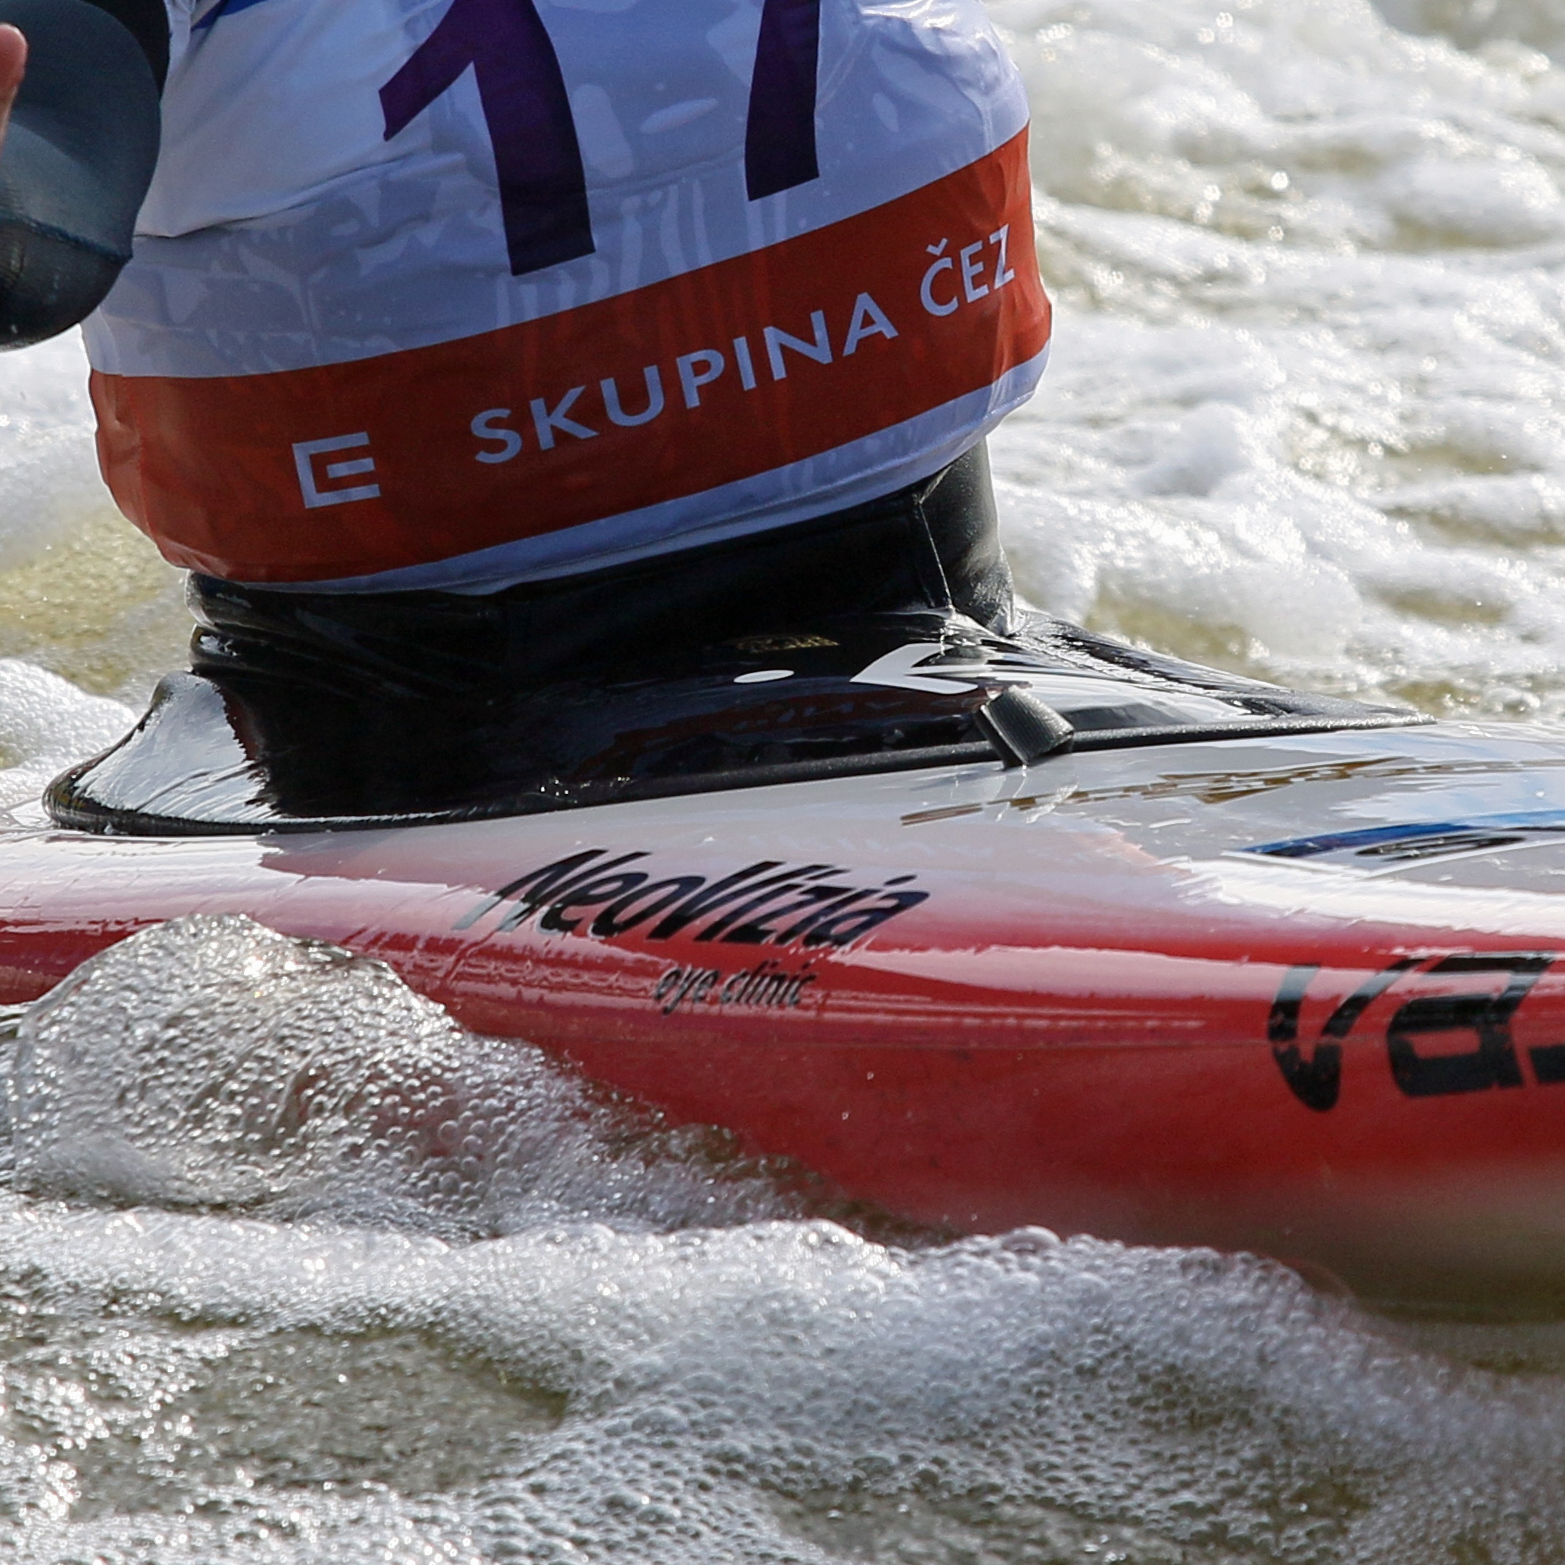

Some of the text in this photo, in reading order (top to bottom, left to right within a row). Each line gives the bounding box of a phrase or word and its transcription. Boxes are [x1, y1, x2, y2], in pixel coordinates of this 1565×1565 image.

[470, 292, 900, 464] SKUPINA
[920, 223, 1015, 318] ČEZ
[653, 959, 819, 1016] eye clinic
